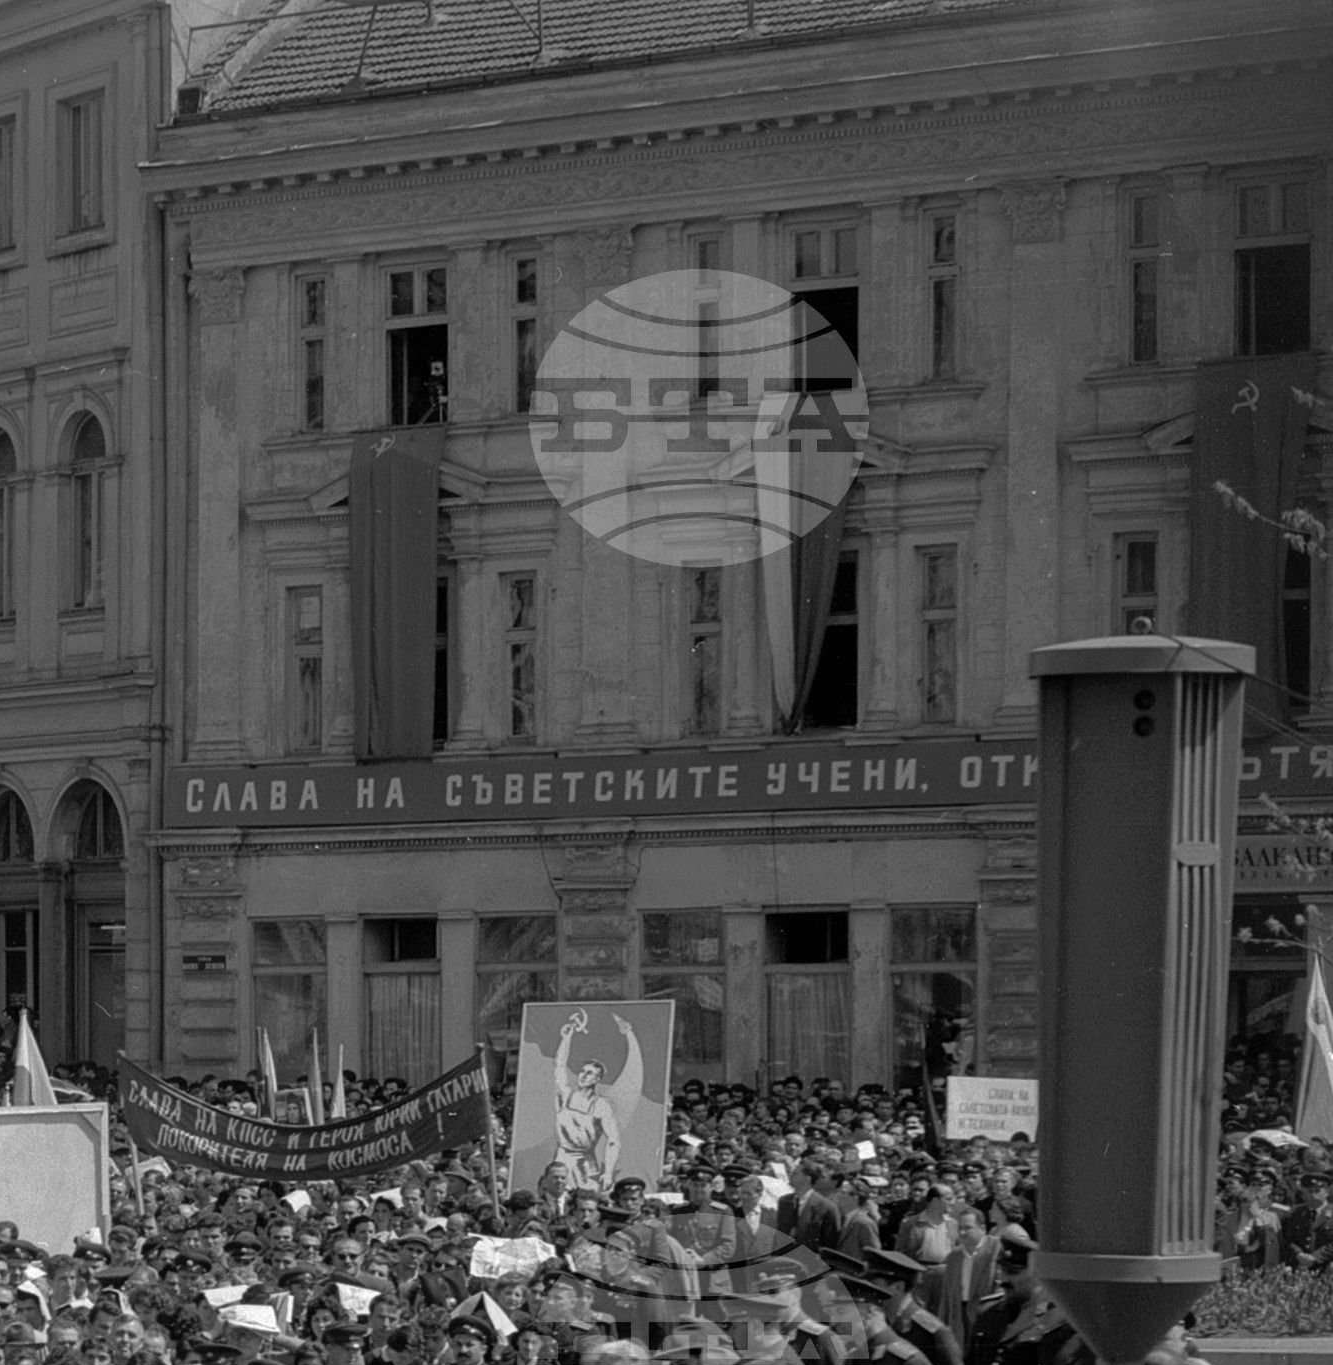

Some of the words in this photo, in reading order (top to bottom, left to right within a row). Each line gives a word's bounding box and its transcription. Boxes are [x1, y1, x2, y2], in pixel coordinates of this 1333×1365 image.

[186, 778, 319, 813] СЛАВА
[356, 777, 405, 809] НА
[445, 765, 738, 806] СЪВЕТСКИТЕ
[766, 757, 930, 795] УЧЕНИ,
[960, 754, 1039, 788] ОТК
[129, 1080, 181, 1123] СЛАВА
[194, 1108, 218, 1135] НА
[226, 1117, 278, 1147] КПСС
[286, 1131, 300, 1149] И
[309, 1124, 365, 1149] ГЕРОЯ
[426, 1067, 487, 1113] ГАГАРИ
[157, 1123, 269, 1171] ПОКОРИТЕЛЯ
[283, 1154, 307, 1172] НА
[327, 1130, 414, 1171] КОСМОСА
